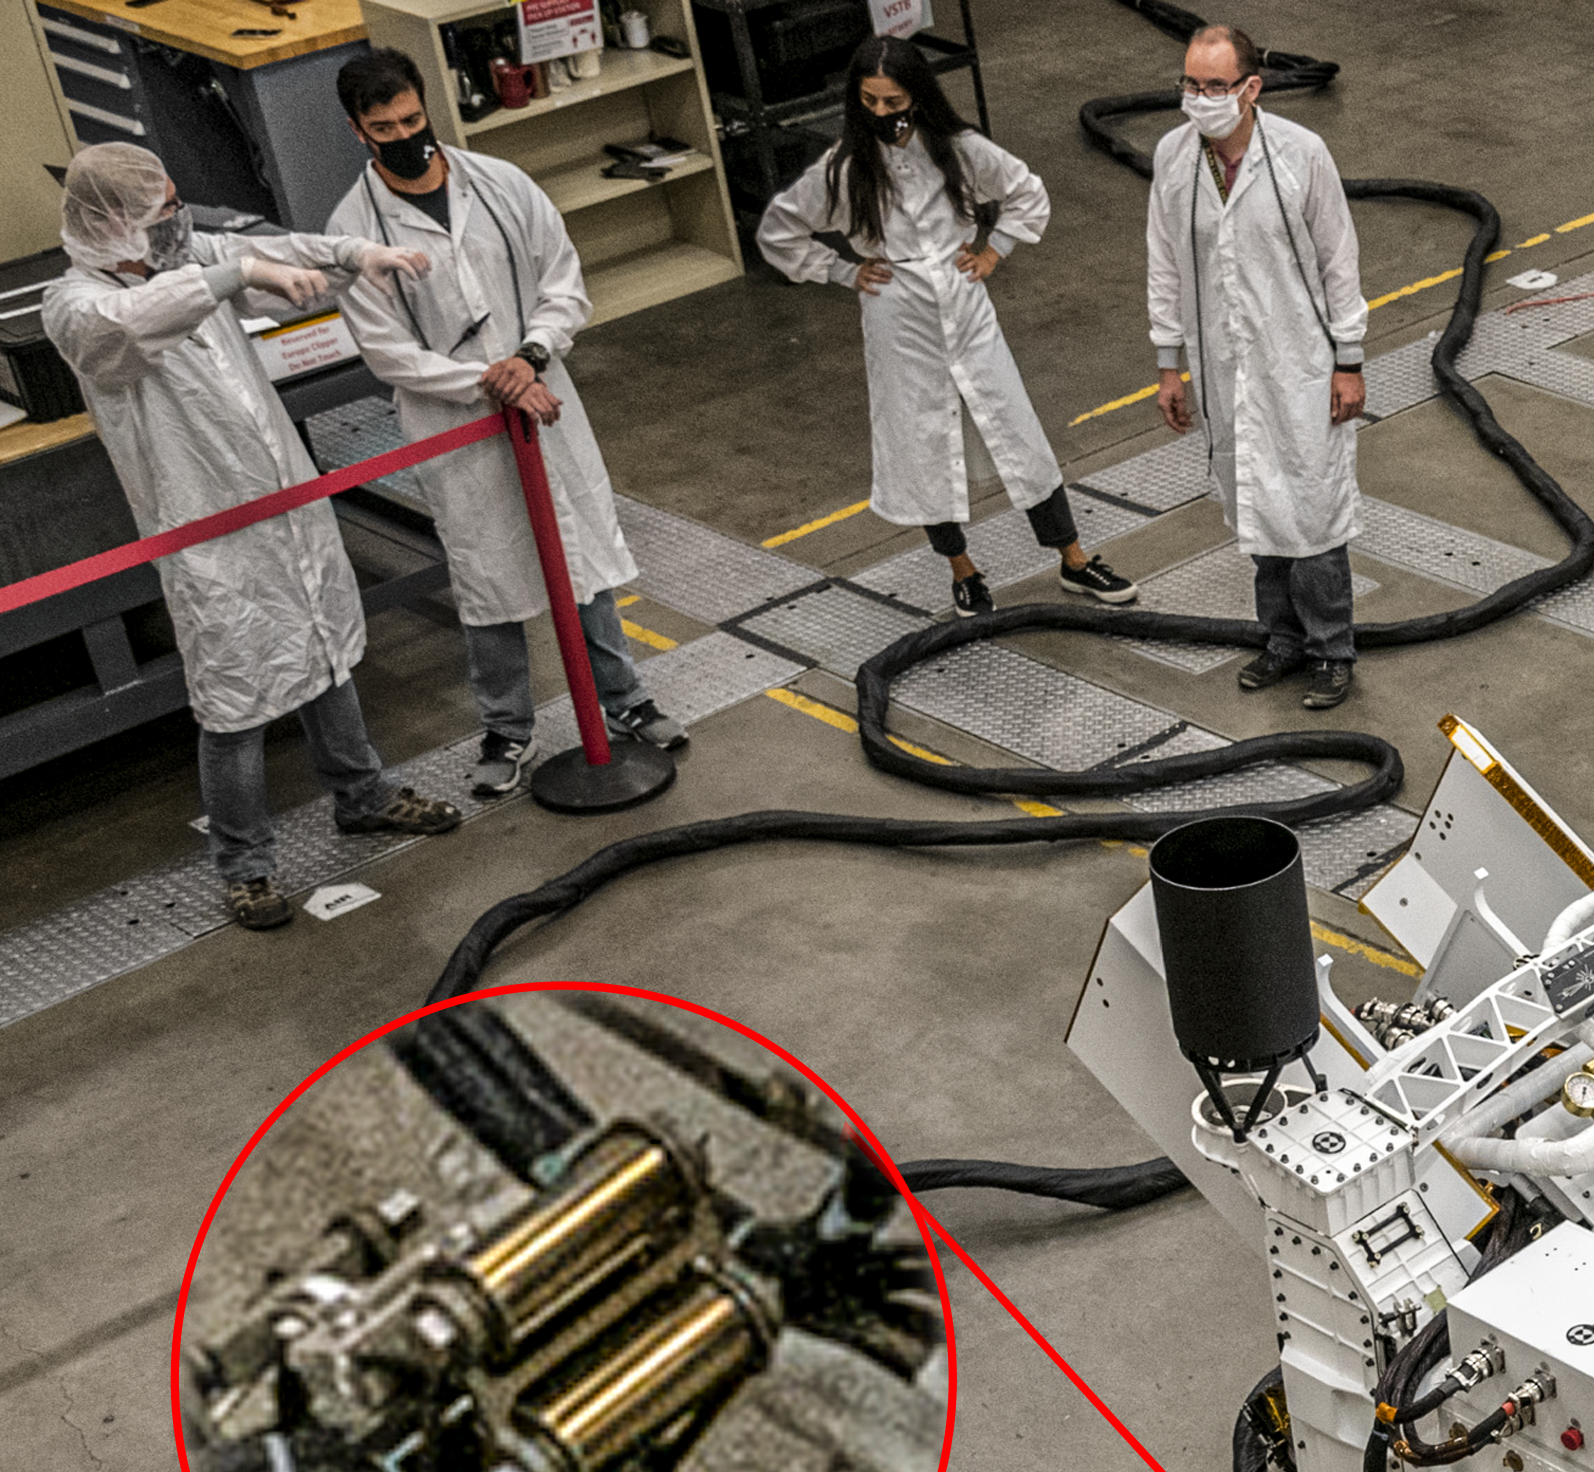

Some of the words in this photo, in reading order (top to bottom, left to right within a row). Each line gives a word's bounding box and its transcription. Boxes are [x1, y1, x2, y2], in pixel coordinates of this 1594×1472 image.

[281, 329, 317, 345] Reserved
[281, 346, 310, 360] Europa
[311, 337, 338, 351] Clipper
[288, 362, 300, 371] Do
[302, 357, 316, 367] Not
[317, 349, 341, 362] Touch
